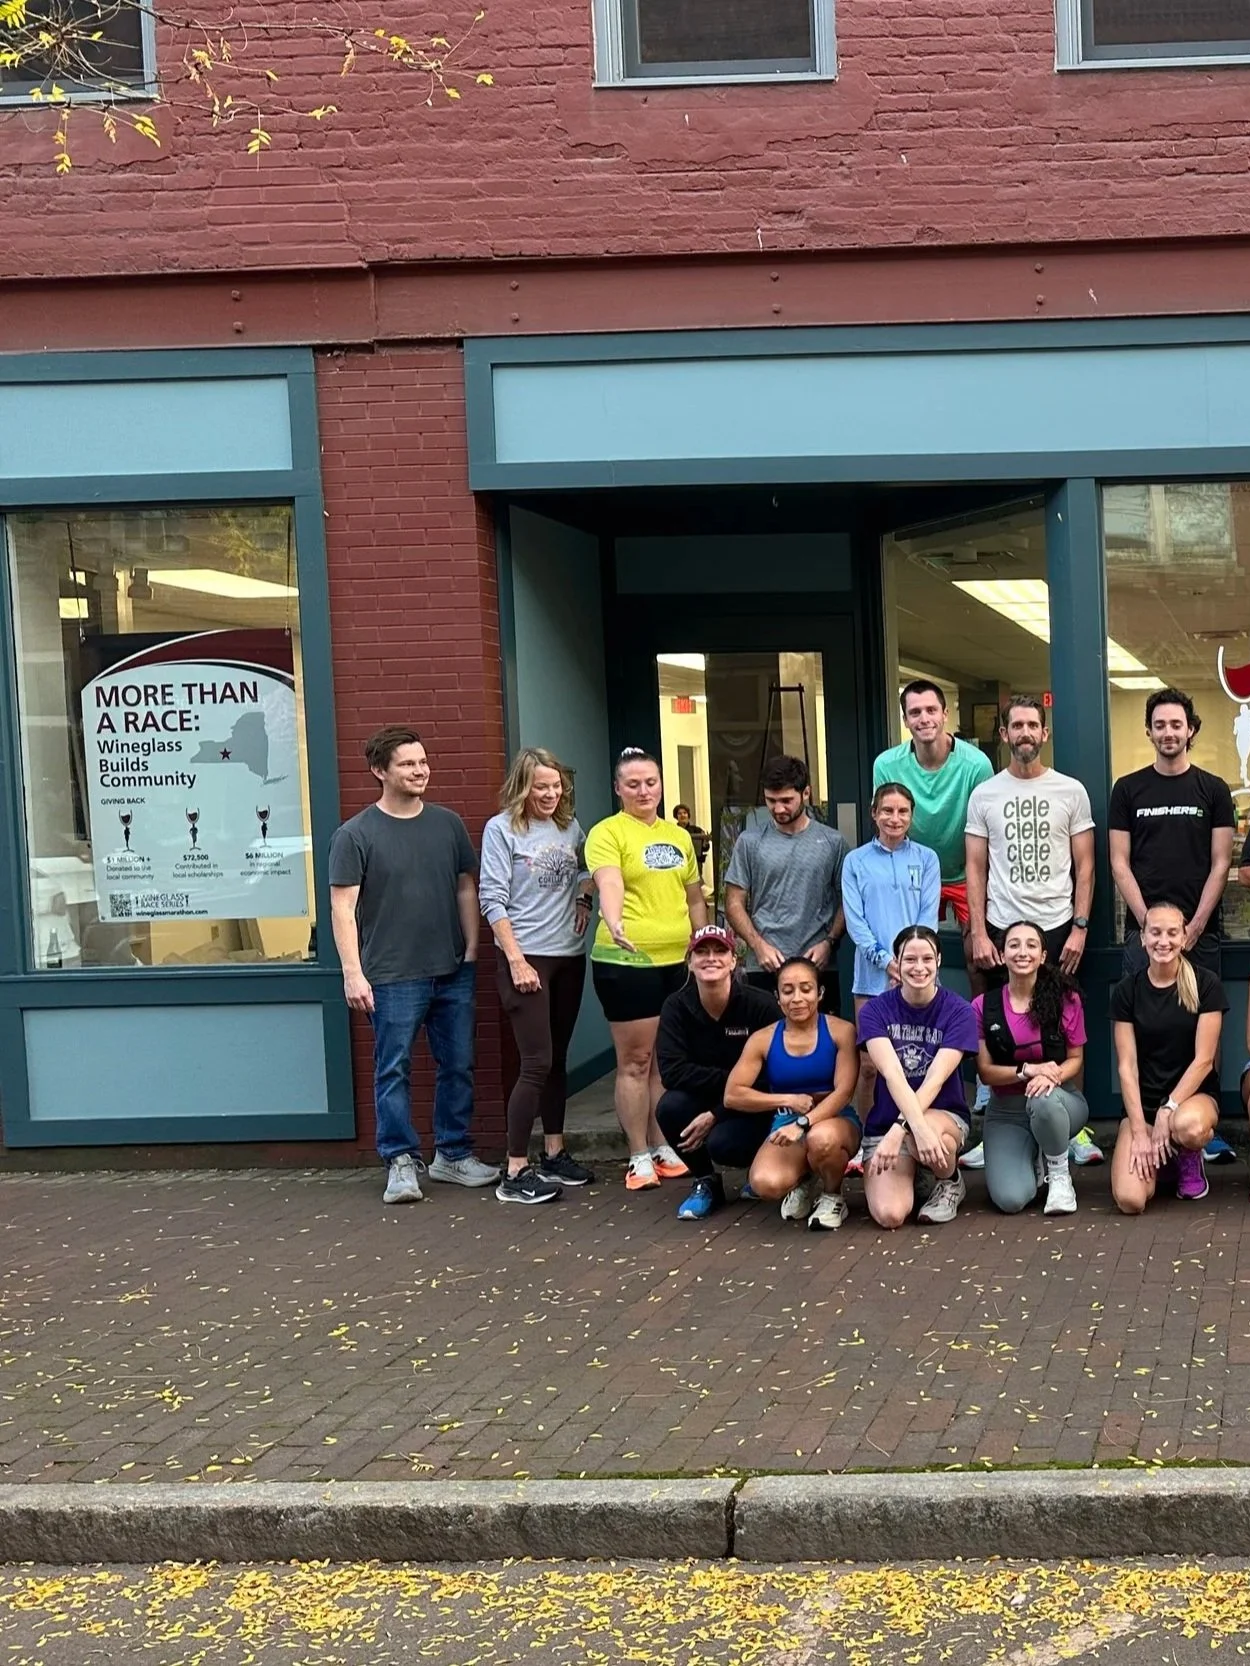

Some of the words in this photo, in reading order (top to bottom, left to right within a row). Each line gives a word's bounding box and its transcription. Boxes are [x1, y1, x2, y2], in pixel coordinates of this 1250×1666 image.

[95, 684, 174, 708] MORE
[182, 681, 258, 705] THAN
[96, 712, 116, 734] A
[124, 710, 200, 733] RACE:
[97, 738, 183, 757] Wineglass
[99, 757, 149, 773] Builds
[100, 771, 197, 789] Community
[1003, 796, 1050, 819] ciele
[1136, 806, 1198, 818] FINISHERS
[1005, 818, 1050, 840] ciele
[1007, 841, 1050, 862] ciele
[188, 871, 223, 879] scholarships
[1009, 862, 1051, 883] ciele
[136, 909, 208, 918] wineglassmarathon.com
[695, 925, 726, 939] WGM
